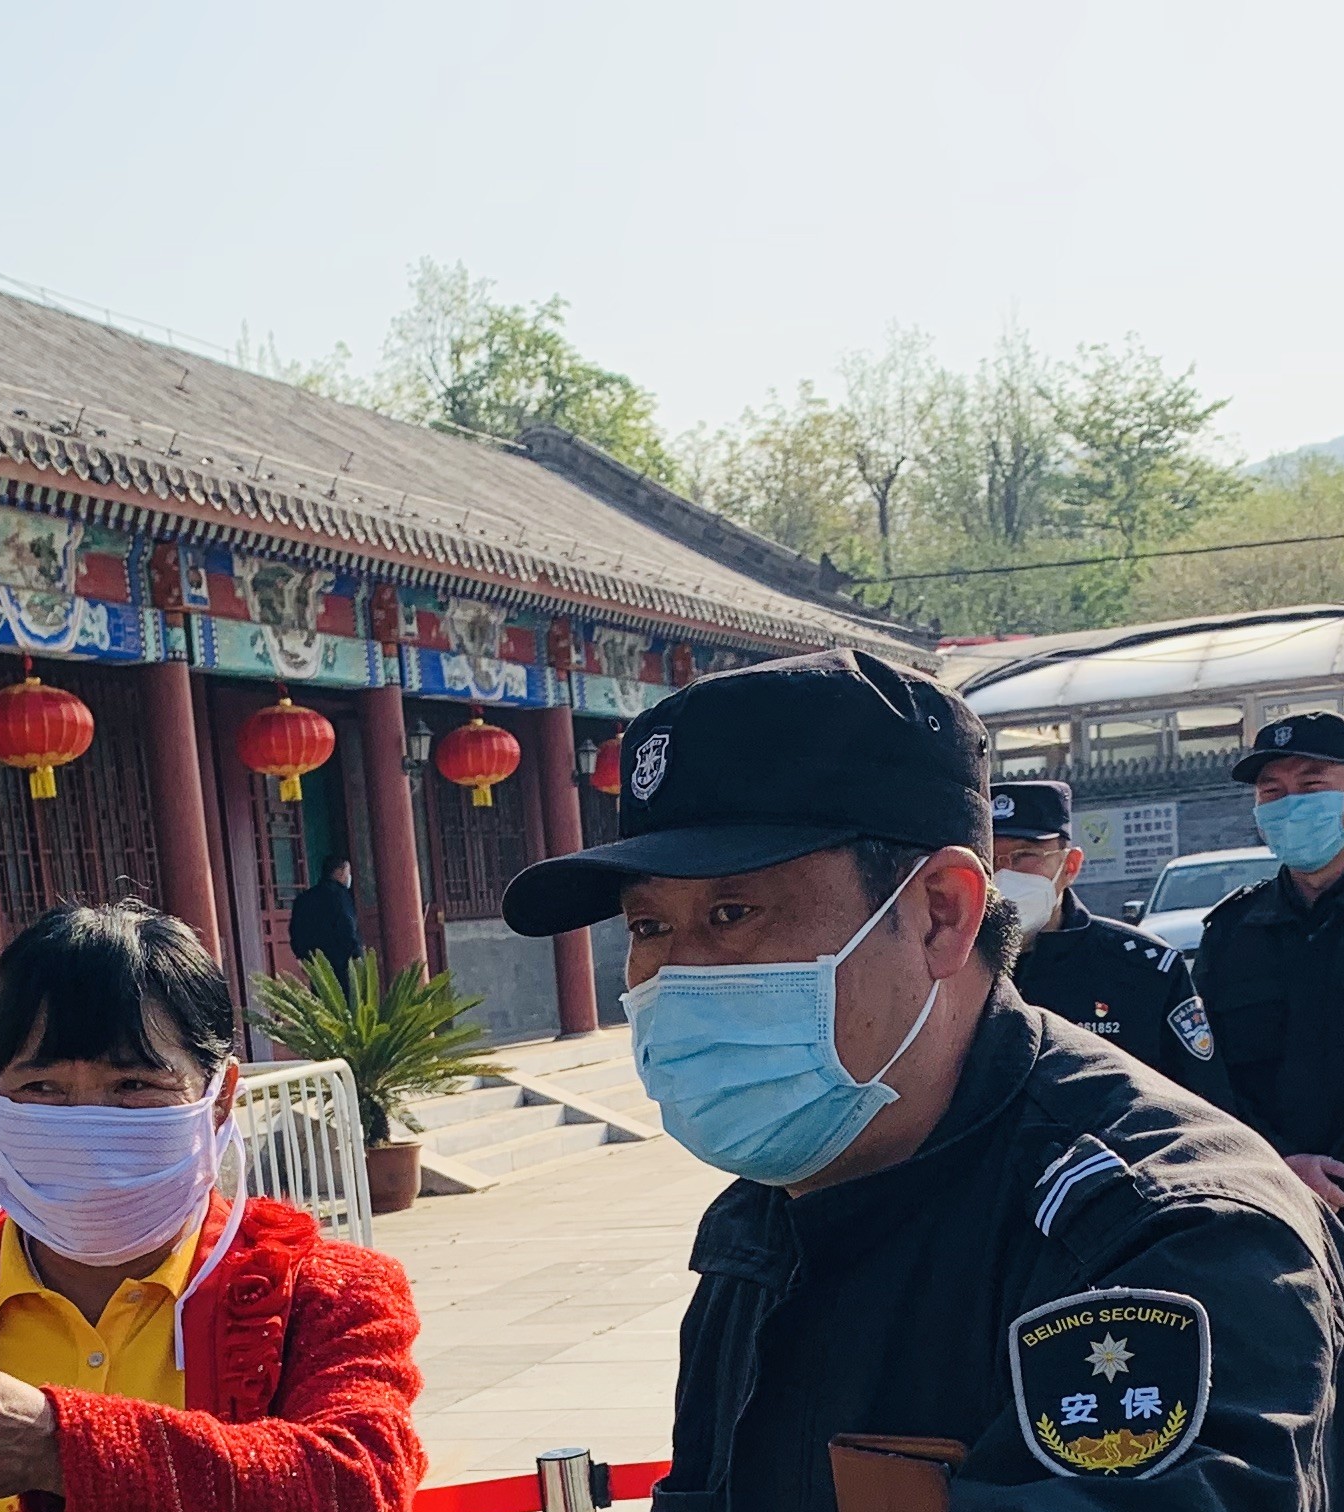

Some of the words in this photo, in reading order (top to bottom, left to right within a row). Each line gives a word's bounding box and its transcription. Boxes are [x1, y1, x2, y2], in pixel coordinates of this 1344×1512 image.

[1022, 1310, 1094, 1348] BEIJING
[1098, 1306, 1194, 1332] SECURITY
[1060, 1386, 1163, 1426] 安保
